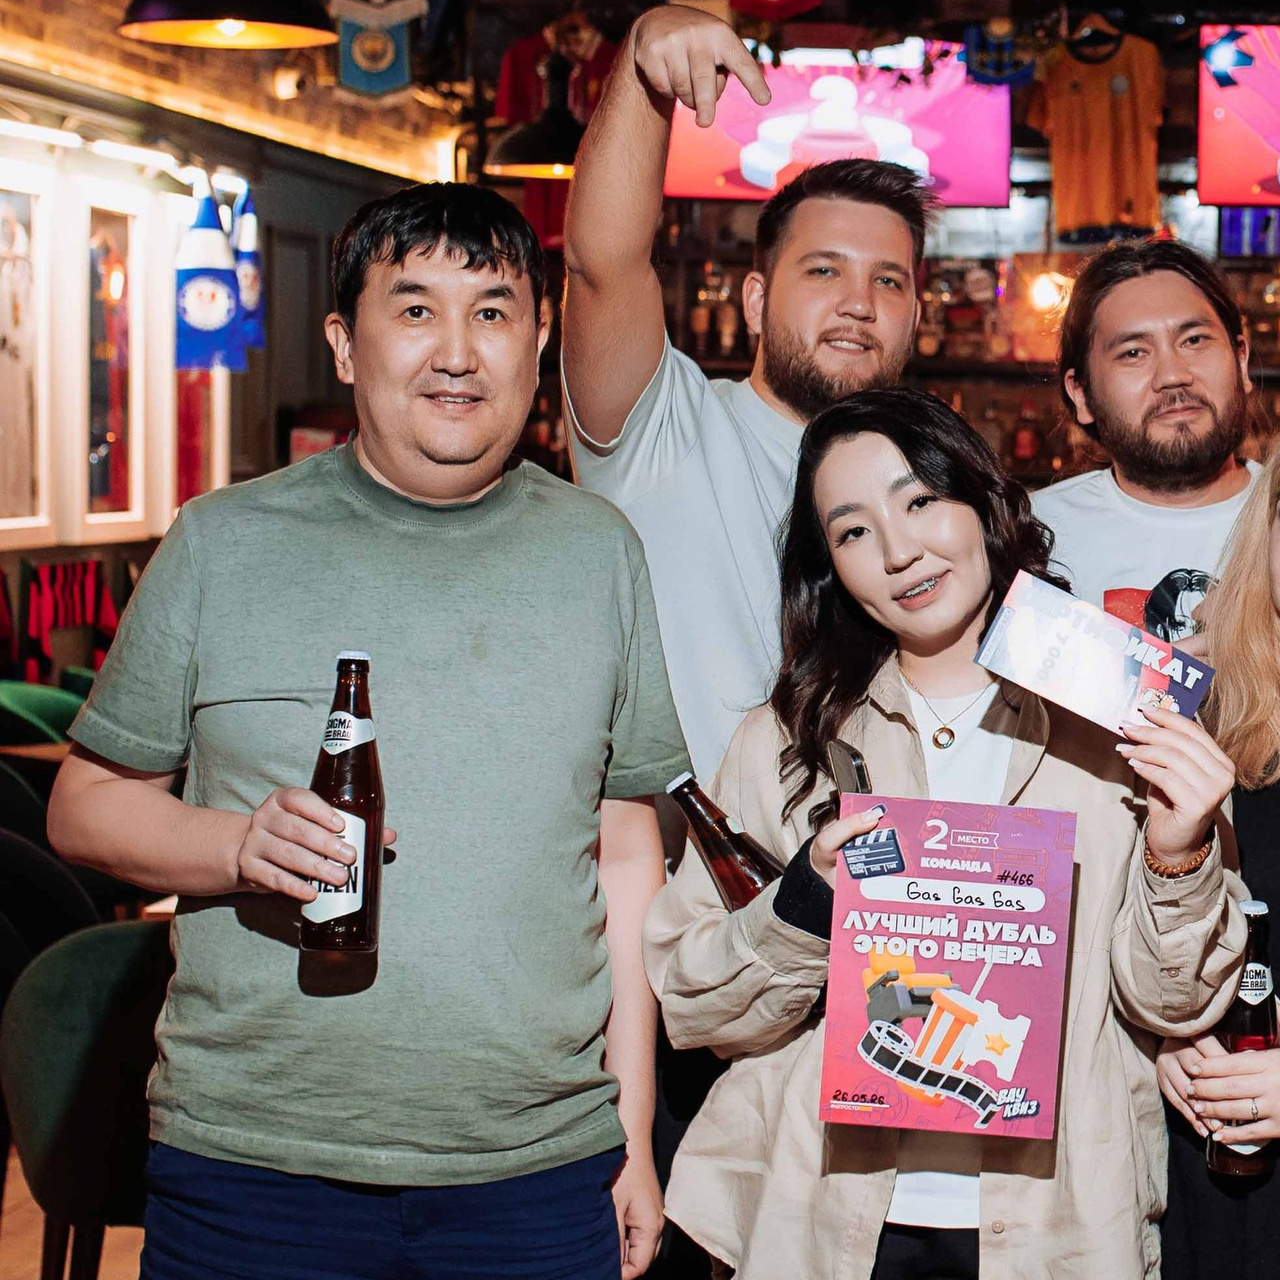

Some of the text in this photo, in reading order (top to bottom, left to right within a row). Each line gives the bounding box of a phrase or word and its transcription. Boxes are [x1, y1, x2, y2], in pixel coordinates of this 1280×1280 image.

[327, 718, 353, 730] SIGMA
[923, 819, 990, 850] 2 МЕСТО
[920, 856, 992, 873] КОМАНДА
[996, 870, 1034, 886] #466
[906, 881, 1026, 911] Gas Gas Gas
[842, 910, 1058, 945] ЛУЧШИЙ ДУБЛЬ
[853, 933, 1044, 967] ЭТОГО ВЕЧЕРА
[997, 1087, 1026, 1105] ВАУ
[1003, 1101, 1038, 1118] КВИЗ
